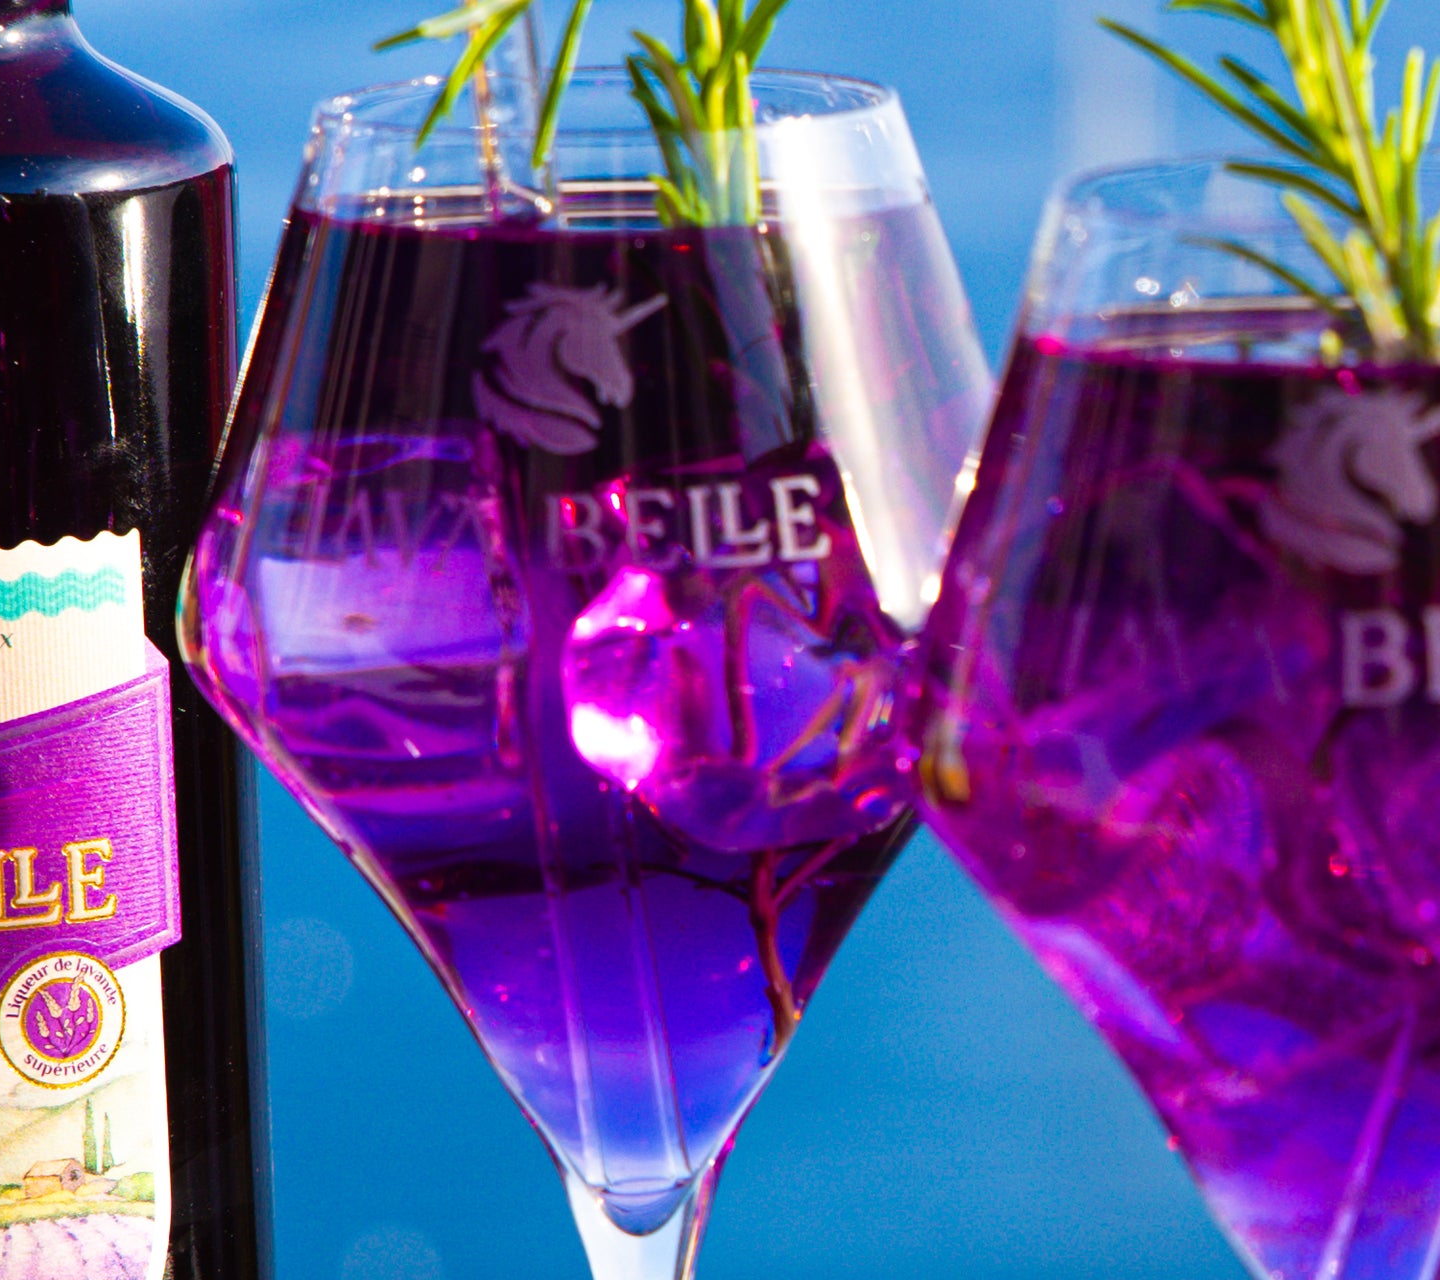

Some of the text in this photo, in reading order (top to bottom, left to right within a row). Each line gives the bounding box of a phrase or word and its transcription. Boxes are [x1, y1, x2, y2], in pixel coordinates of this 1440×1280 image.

[545, 474, 831, 571] BELLE
[6, 958, 117, 1018] Liqueur de lavande
[24, 1043, 108, 1077] supérieure
